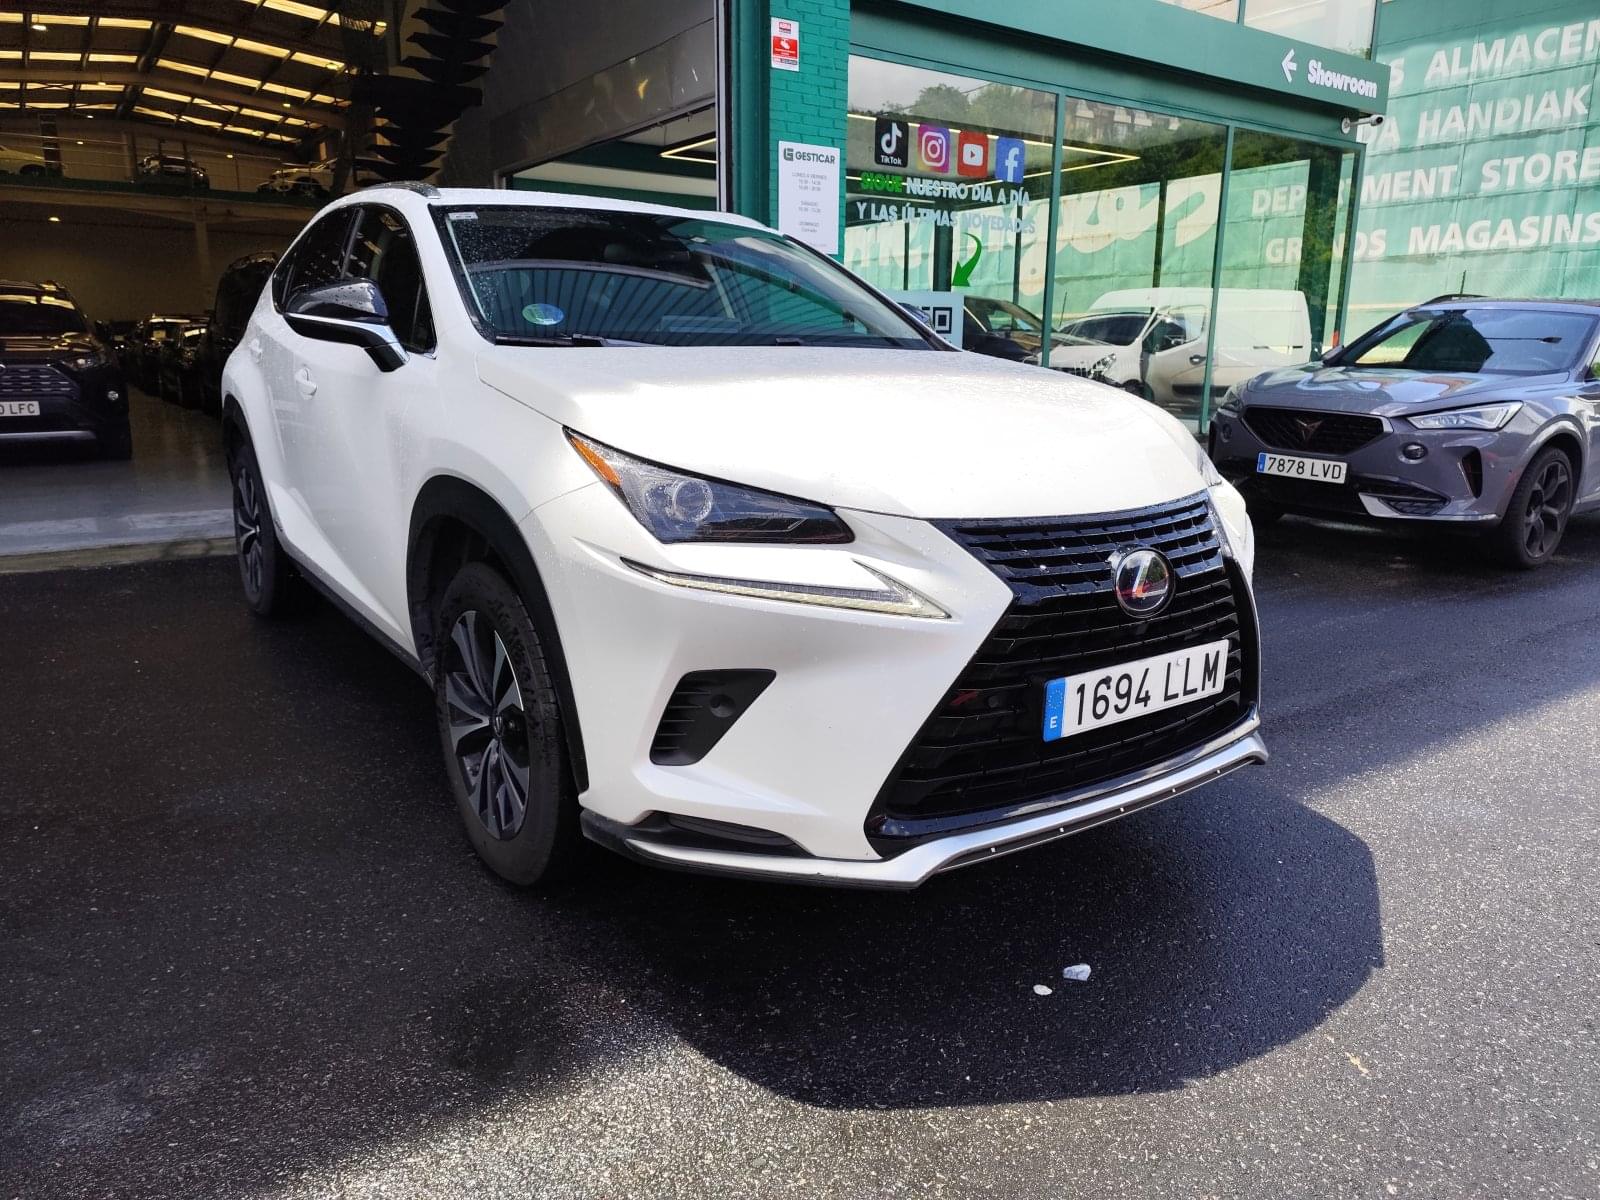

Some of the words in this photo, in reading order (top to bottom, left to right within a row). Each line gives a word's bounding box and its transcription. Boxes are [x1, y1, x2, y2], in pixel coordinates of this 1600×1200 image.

[1307, 59, 1378, 99] Showroom
[1416, 84, 1591, 145] HANDIAK
[795, 151, 836, 165] GESTICAR
[880, 155, 902, 165] TikTok
[860, 172, 903, 193] SIGUE
[906, 176, 968, 199] NUESTRO
[997, 188, 1007, 204] A
[1010, 187, 1030, 207] DÍA
[856, 202, 867, 219] Y
[870, 203, 898, 222] LAS
[902, 203, 957, 227] ÚLTIMAS
[962, 213, 1035, 233] NOVEDADES
[1408, 212, 1600, 256] MAGASINS
[10, 403, 35, 415] LFC
[1267, 457, 1305, 474] 7878
[1310, 461, 1342, 479] LVD
[1076, 667, 1151, 726] 1694
[1163, 650, 1220, 702] LLM
[1050, 716, 1058, 728] E
